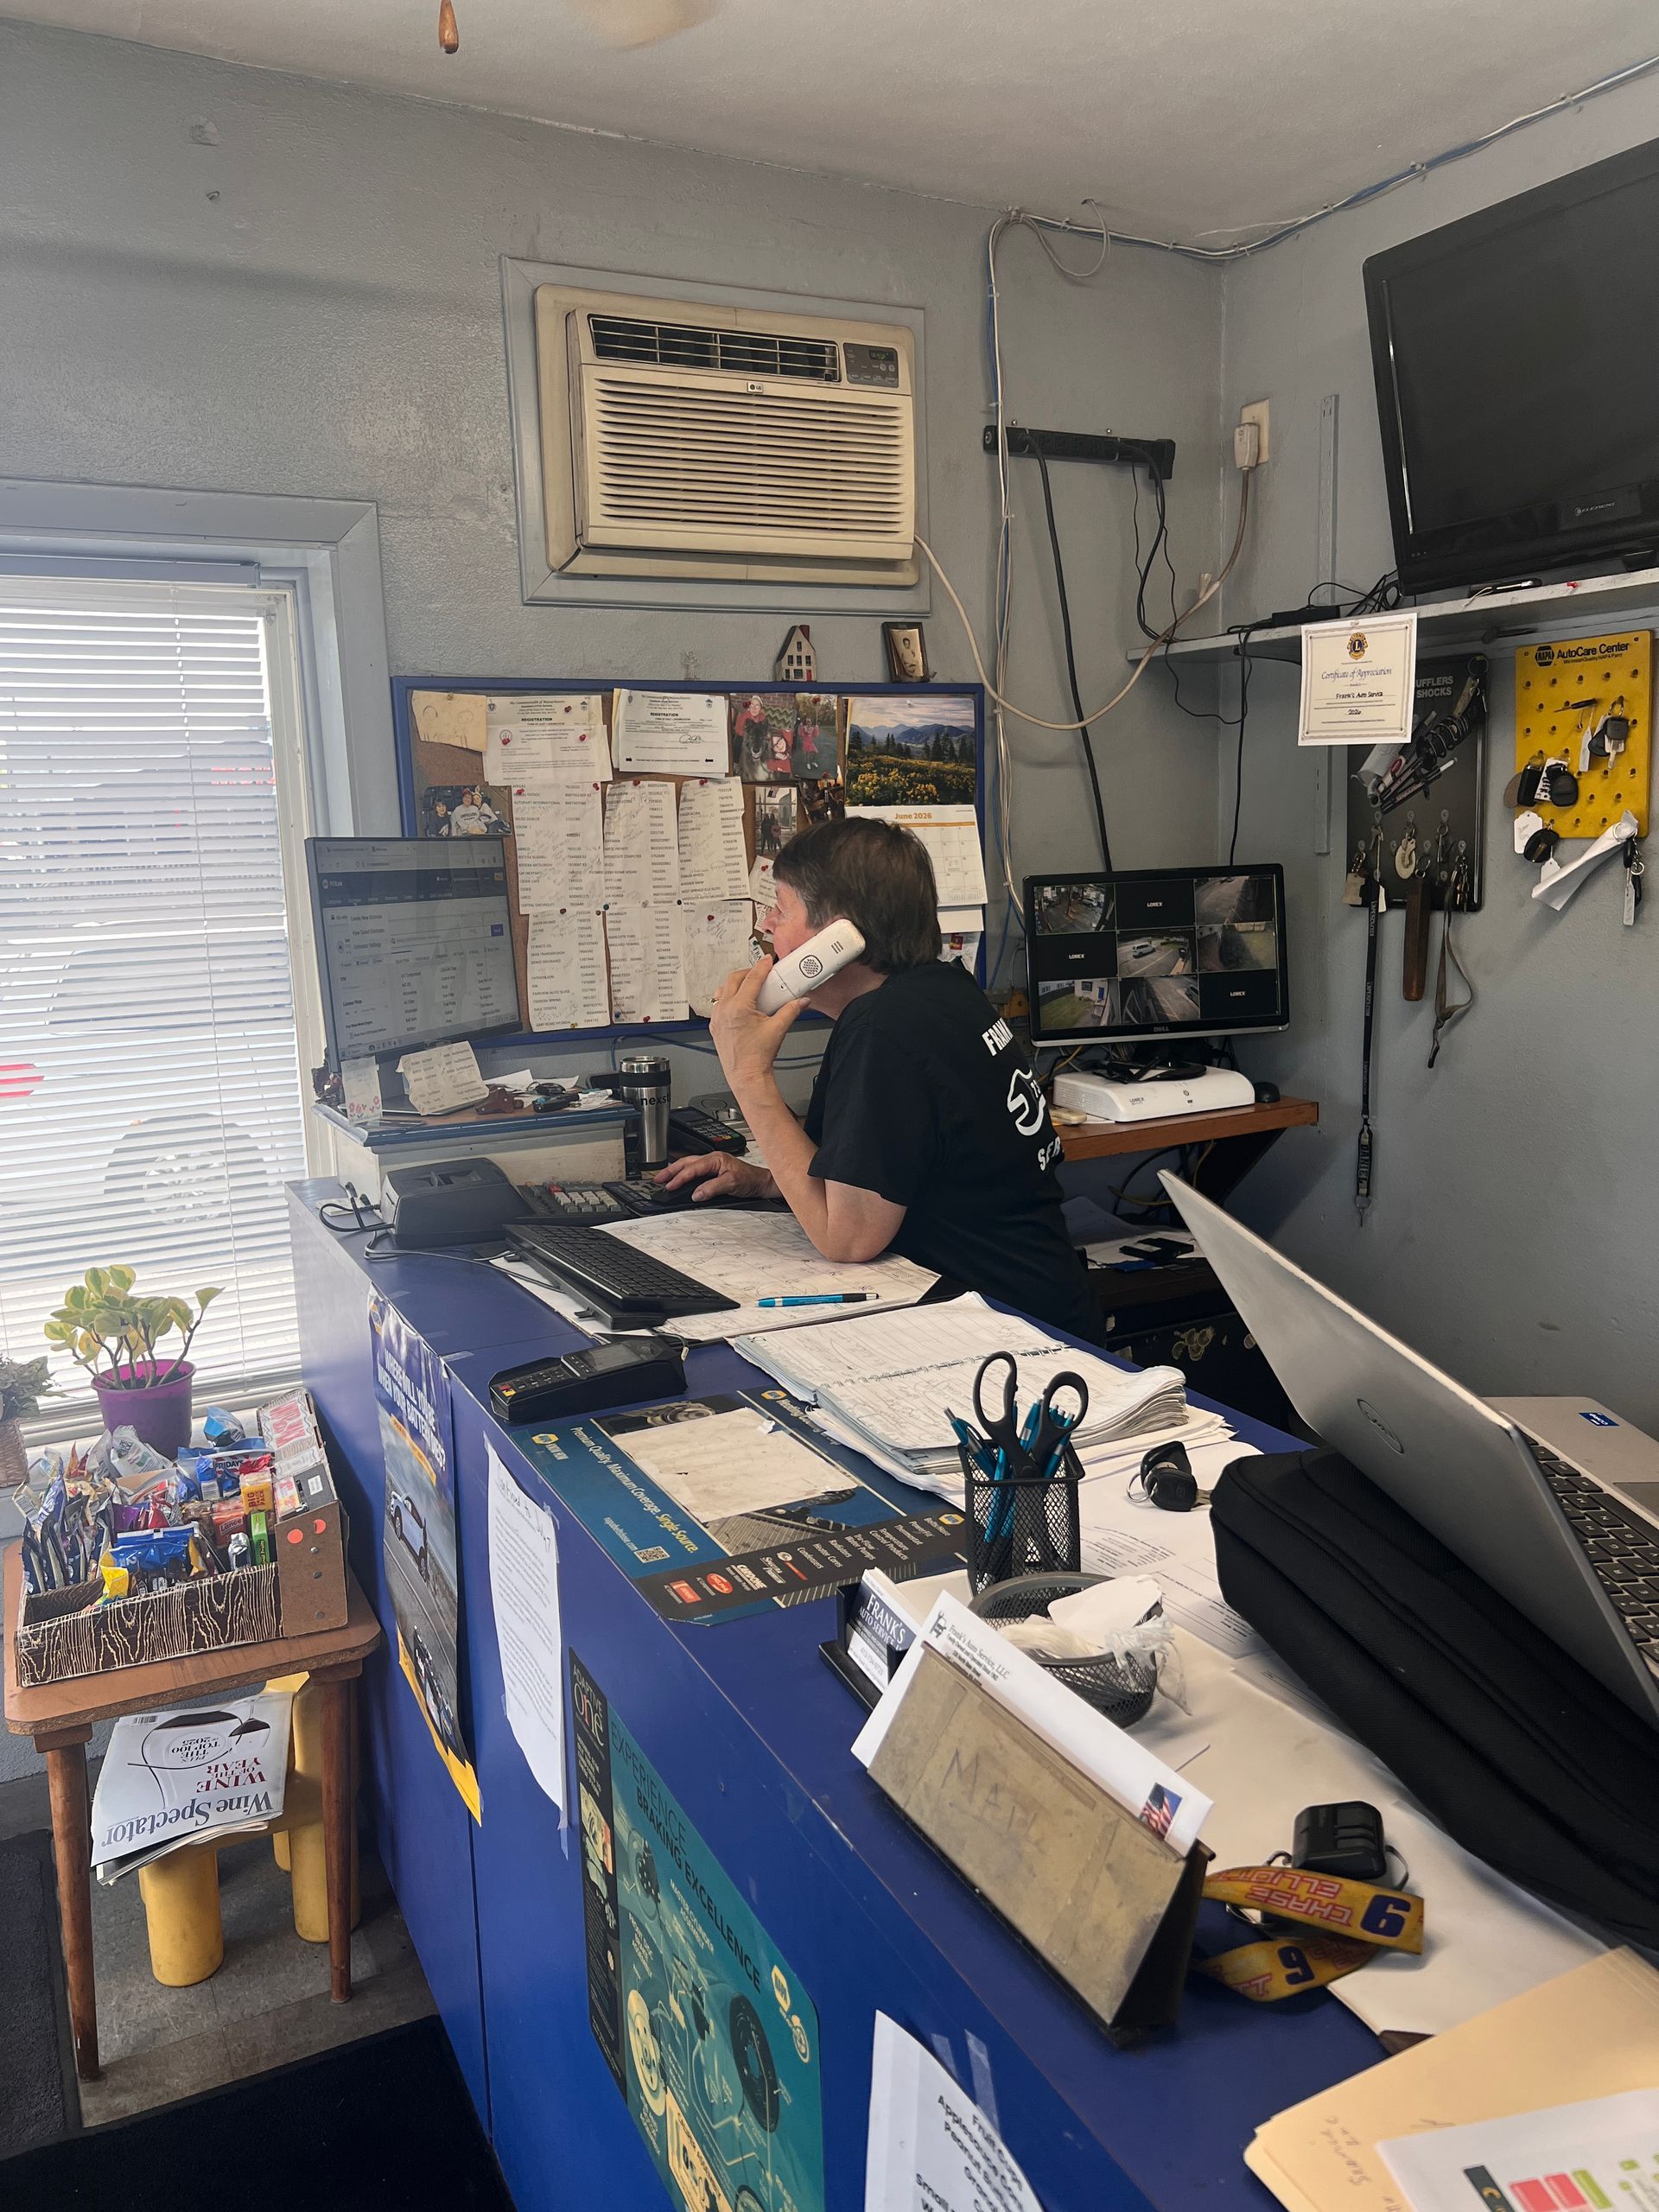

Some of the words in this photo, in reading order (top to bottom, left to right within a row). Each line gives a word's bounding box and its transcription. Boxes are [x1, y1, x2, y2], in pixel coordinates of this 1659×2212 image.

[1536, 651, 1553, 663] NAPA
[1556, 645, 1597, 659] AutoCare
[1599, 642, 1630, 653] Center
[1321, 668, 1349, 683] Certificate
[1349, 668, 1357, 681] of
[1356, 667, 1392, 681] Appreciation
[1415, 676, 1453, 687] UFFLERS
[1416, 686, 1452, 698] SHOCKS
[570, 1427, 595, 1452] Premium
[607, 1463, 636, 1491] Maximum
[631, 1487, 661, 1515] Coverage.
[656, 1513, 681, 1533] Single
[671, 1528, 699, 1554] Source.
[220, 1518, 243, 1531] Lance
[736, 1564, 767, 1590] CARDONE
[858, 1606, 874, 1625] AUTO
[867, 1593, 906, 1644] FRANK'S
[949, 1624, 967, 1643] Frank's
[968, 1640, 978, 1653] Auto
[977, 1649, 996, 1670] Service,
[995, 1664, 1010, 1680] LLC
[573, 1664, 603, 1719] ADAPTIVE
[171, 1745, 195, 1755] 100
[181, 1735, 211, 1745] 2025
[197, 1741, 221, 1751] TOP
[207, 1757, 262, 1774] YEAR
[196, 1771, 266, 1794] WINE
[611, 1719, 688, 1857] EXPERIENCE
[216, 1790, 274, 1816] Wine
[101, 1797, 212, 1847] Spectator
[636, 1786, 683, 1871] BRAKING
[683, 1859, 761, 1995] EXCELLENCE
[1247, 1885, 1353, 1927] CHASE
[938, 2094, 999, 2177] Applesauce
[972, 2114, 996, 2150] Fruit
[944, 2120, 982, 2174] Peanut
